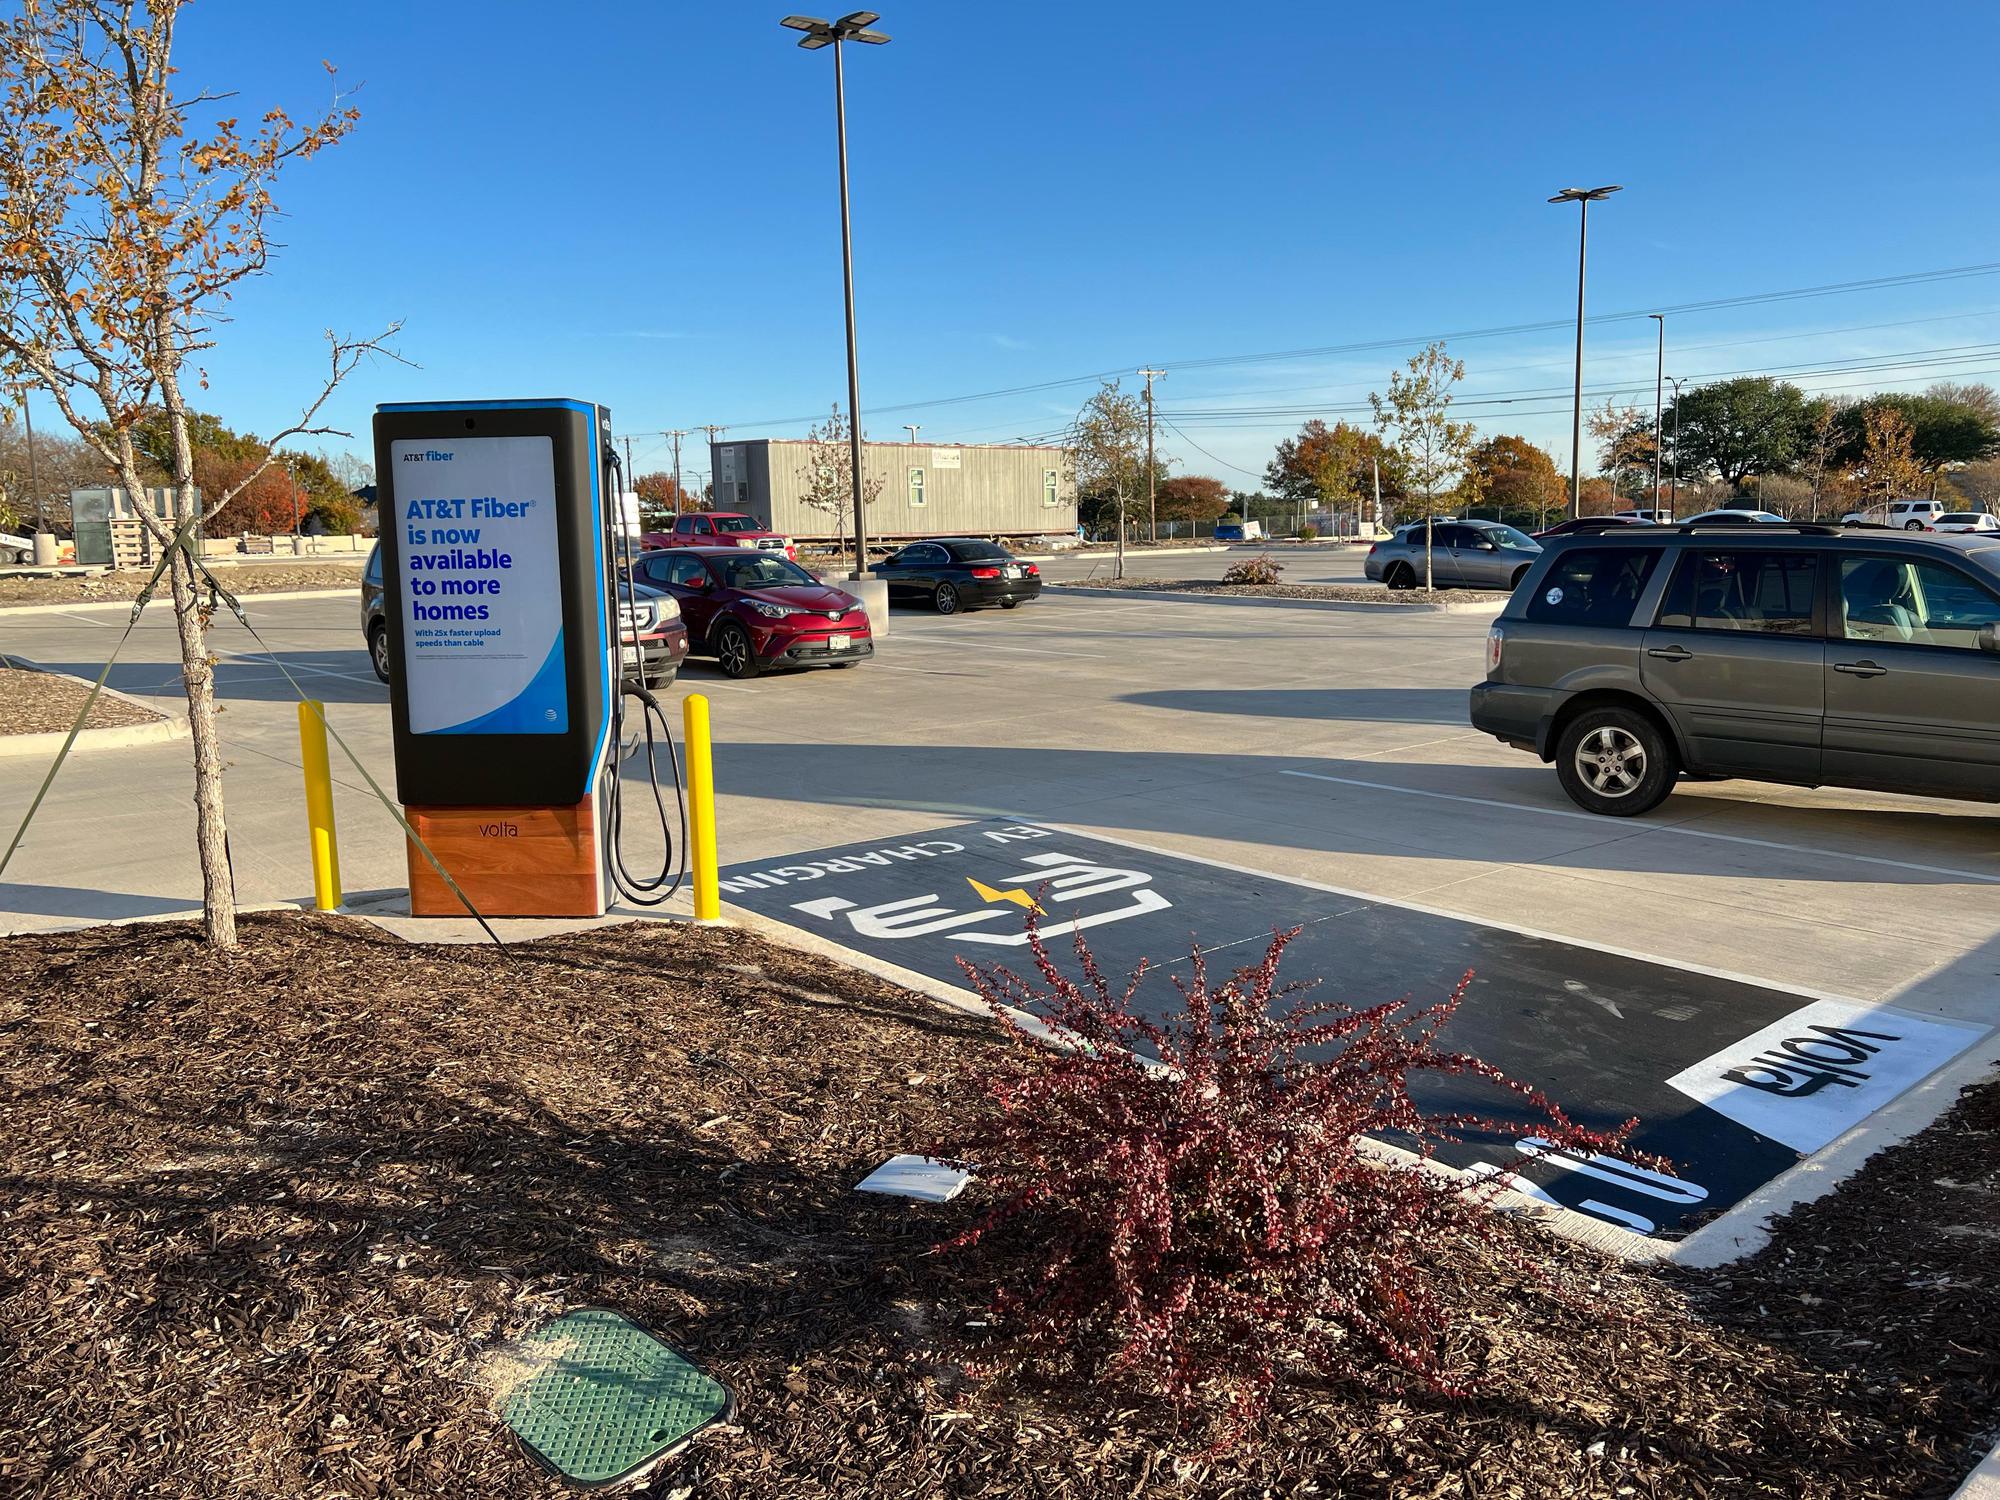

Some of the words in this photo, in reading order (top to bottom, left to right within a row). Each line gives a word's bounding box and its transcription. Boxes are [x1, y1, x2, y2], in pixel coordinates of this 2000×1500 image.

[403, 453, 424, 461] AT&T
[425, 450, 454, 461] fiber
[406, 499, 465, 519] AT&T
[407, 524, 426, 545] is
[432, 529, 480, 544] now
[410, 548, 512, 570] available
[411, 577, 436, 595] to
[441, 579, 501, 595] more
[413, 600, 489, 620] homes
[415, 629, 433, 637] With
[434, 629, 448, 637] 25x
[474, 628, 501, 638] upload
[415, 639, 443, 648] speeds
[444, 639, 462, 647] than
[463, 639, 484, 647] cable
[479, 821, 518, 837] volta
[982, 825, 1054, 844] EV
[716, 841, 965, 894] CHARGIN
[1719, 1024, 1903, 1097] volta
